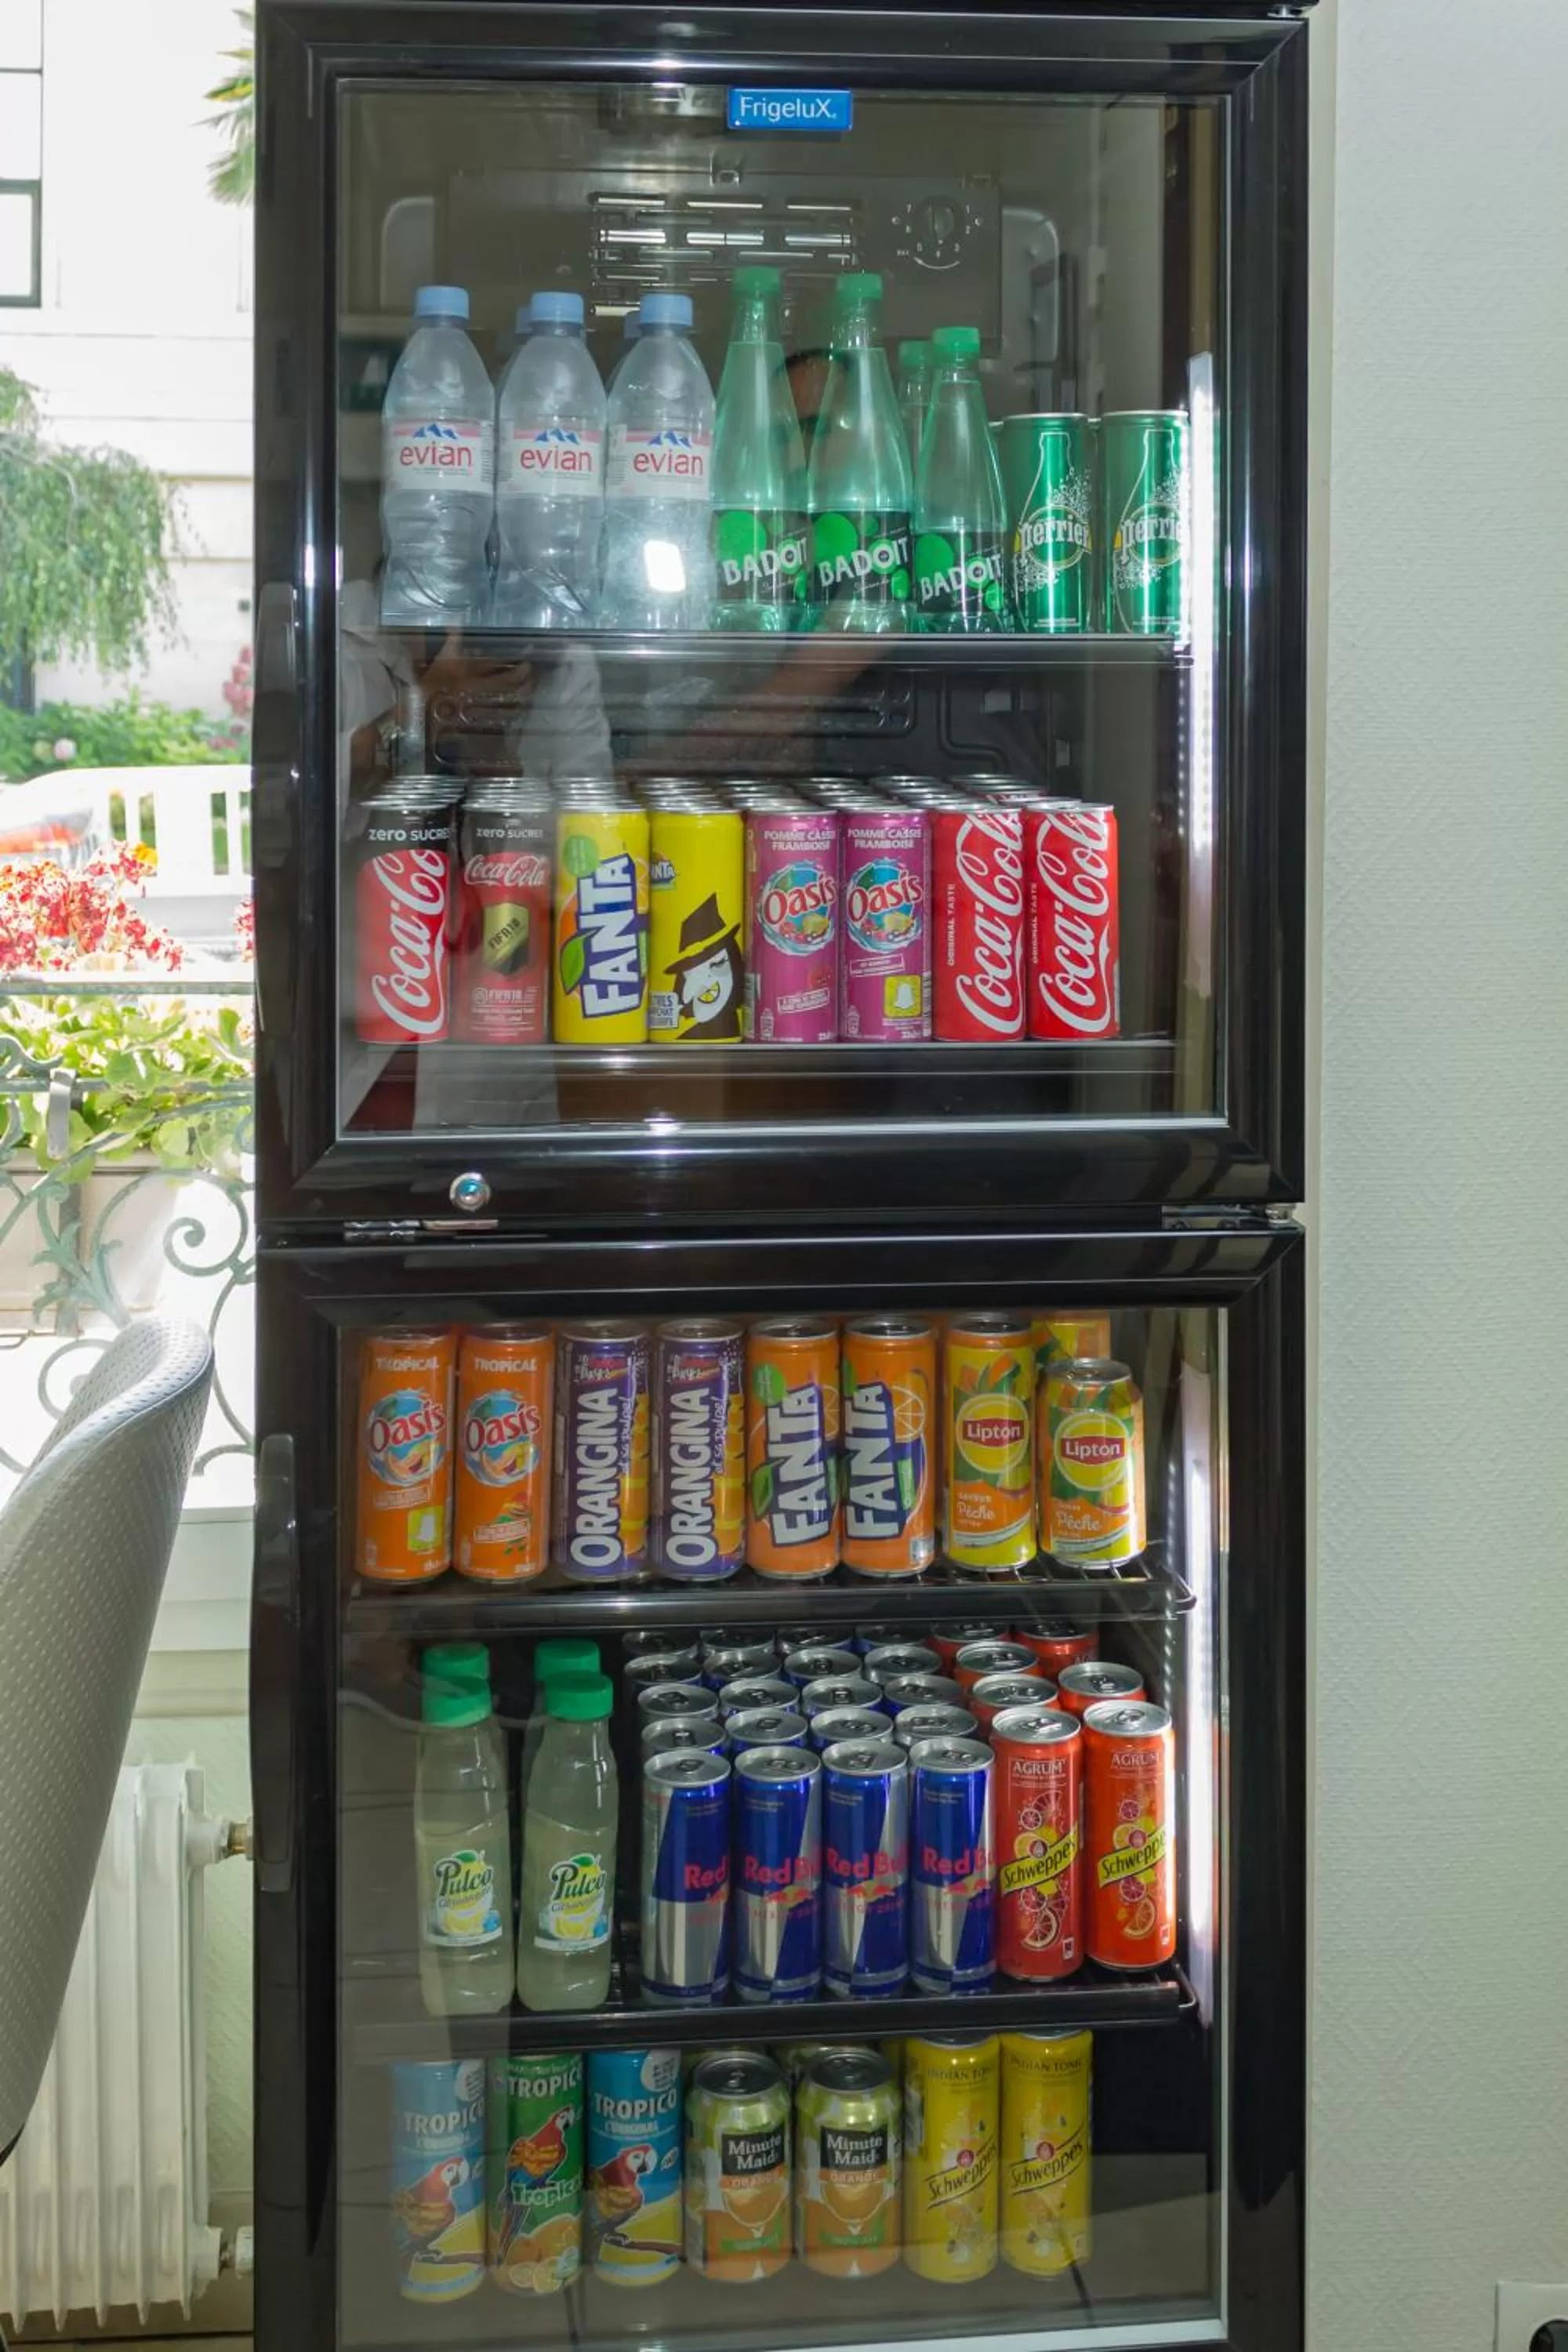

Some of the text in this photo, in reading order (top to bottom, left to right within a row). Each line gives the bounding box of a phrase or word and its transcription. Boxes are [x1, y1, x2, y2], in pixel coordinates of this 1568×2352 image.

[399, 441, 473, 466] evian
[520, 445, 593, 472] evian
[633, 449, 704, 475] evian
[1121, 514, 1181, 564] perri
[720, 536, 808, 586] BADOIT
[818, 535, 909, 587] BADOIT
[920, 553, 1003, 602] BADOIT
[368, 828, 407, 841] zero
[763, 872, 837, 925] Oasis
[847, 870, 924, 923] Oasis
[578, 854, 641, 1018] FANTA
[370, 1403, 445, 1452] Oasis
[466, 1403, 541, 1452] Oasis
[967, 1423, 1020, 1443] Lipton
[767, 1386, 829, 1544] FANTA
[844, 1385, 901, 1538] FANTA
[1065, 1442, 1120, 1459] Lipton
[570, 1387, 622, 1567] ORANGINA
[666, 1387, 717, 1566] ORANGINA
[684, 1857, 728, 1889] Red
[745, 1855, 791, 1884] Red
[827, 1846, 869, 1878] Red
[922, 1846, 971, 1875] Red
[1101, 1833, 1166, 1879] Schweppe
[435, 1859, 493, 1896] Pulco
[551, 1863, 606, 1901] Pulco
[593, 2087, 677, 2120] TROPICO
[728, 2135, 782, 2156] Minute
[736, 2152, 775, 2171] Maid
[826, 2135, 884, 2151] Minute
[834, 2150, 877, 2165] Maid
